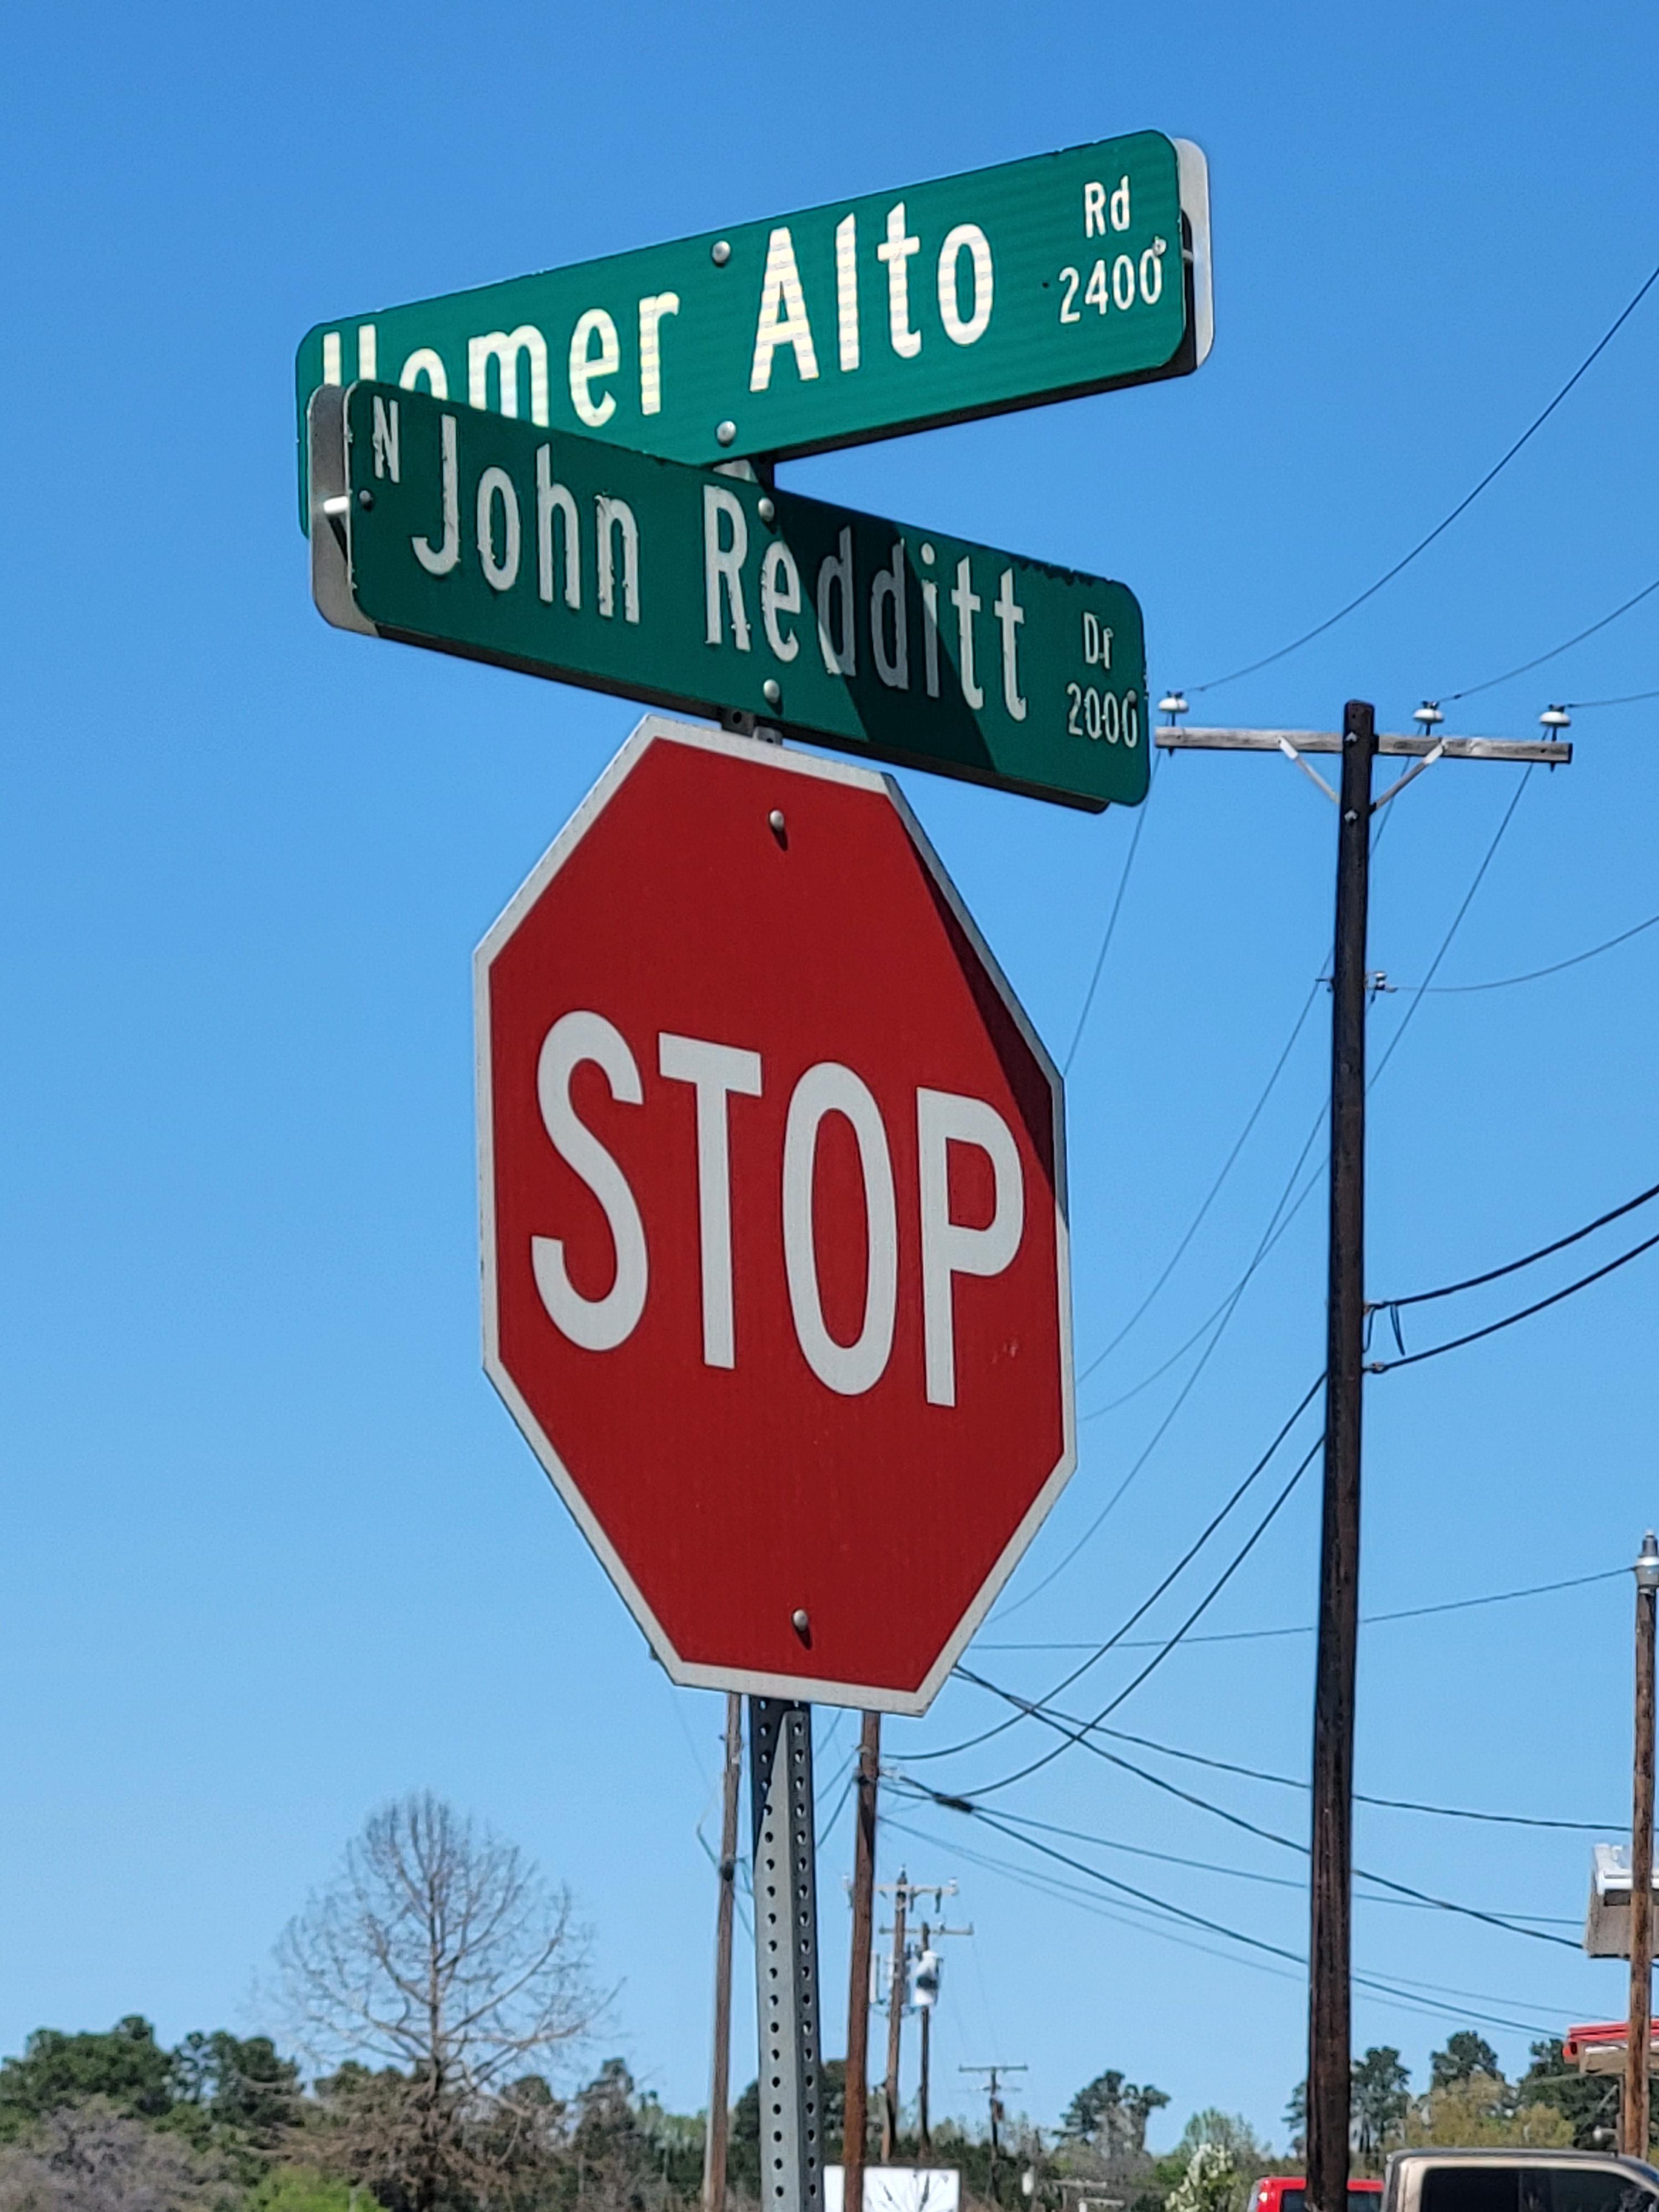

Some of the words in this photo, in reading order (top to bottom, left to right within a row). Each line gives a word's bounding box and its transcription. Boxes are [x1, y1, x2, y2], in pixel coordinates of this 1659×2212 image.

[1085, 176, 1130, 237] Rd
[750, 203, 993, 390] Alto
[1060, 249, 1162, 324] 2400
[373, 396, 400, 483] N
[412, 415, 639, 624] John
[704, 484, 1027, 721] Redditt
[1084, 613, 1113, 668] Dr
[1067, 684, 1138, 748] 2000
[533, 1010, 1024, 1406] STOP
